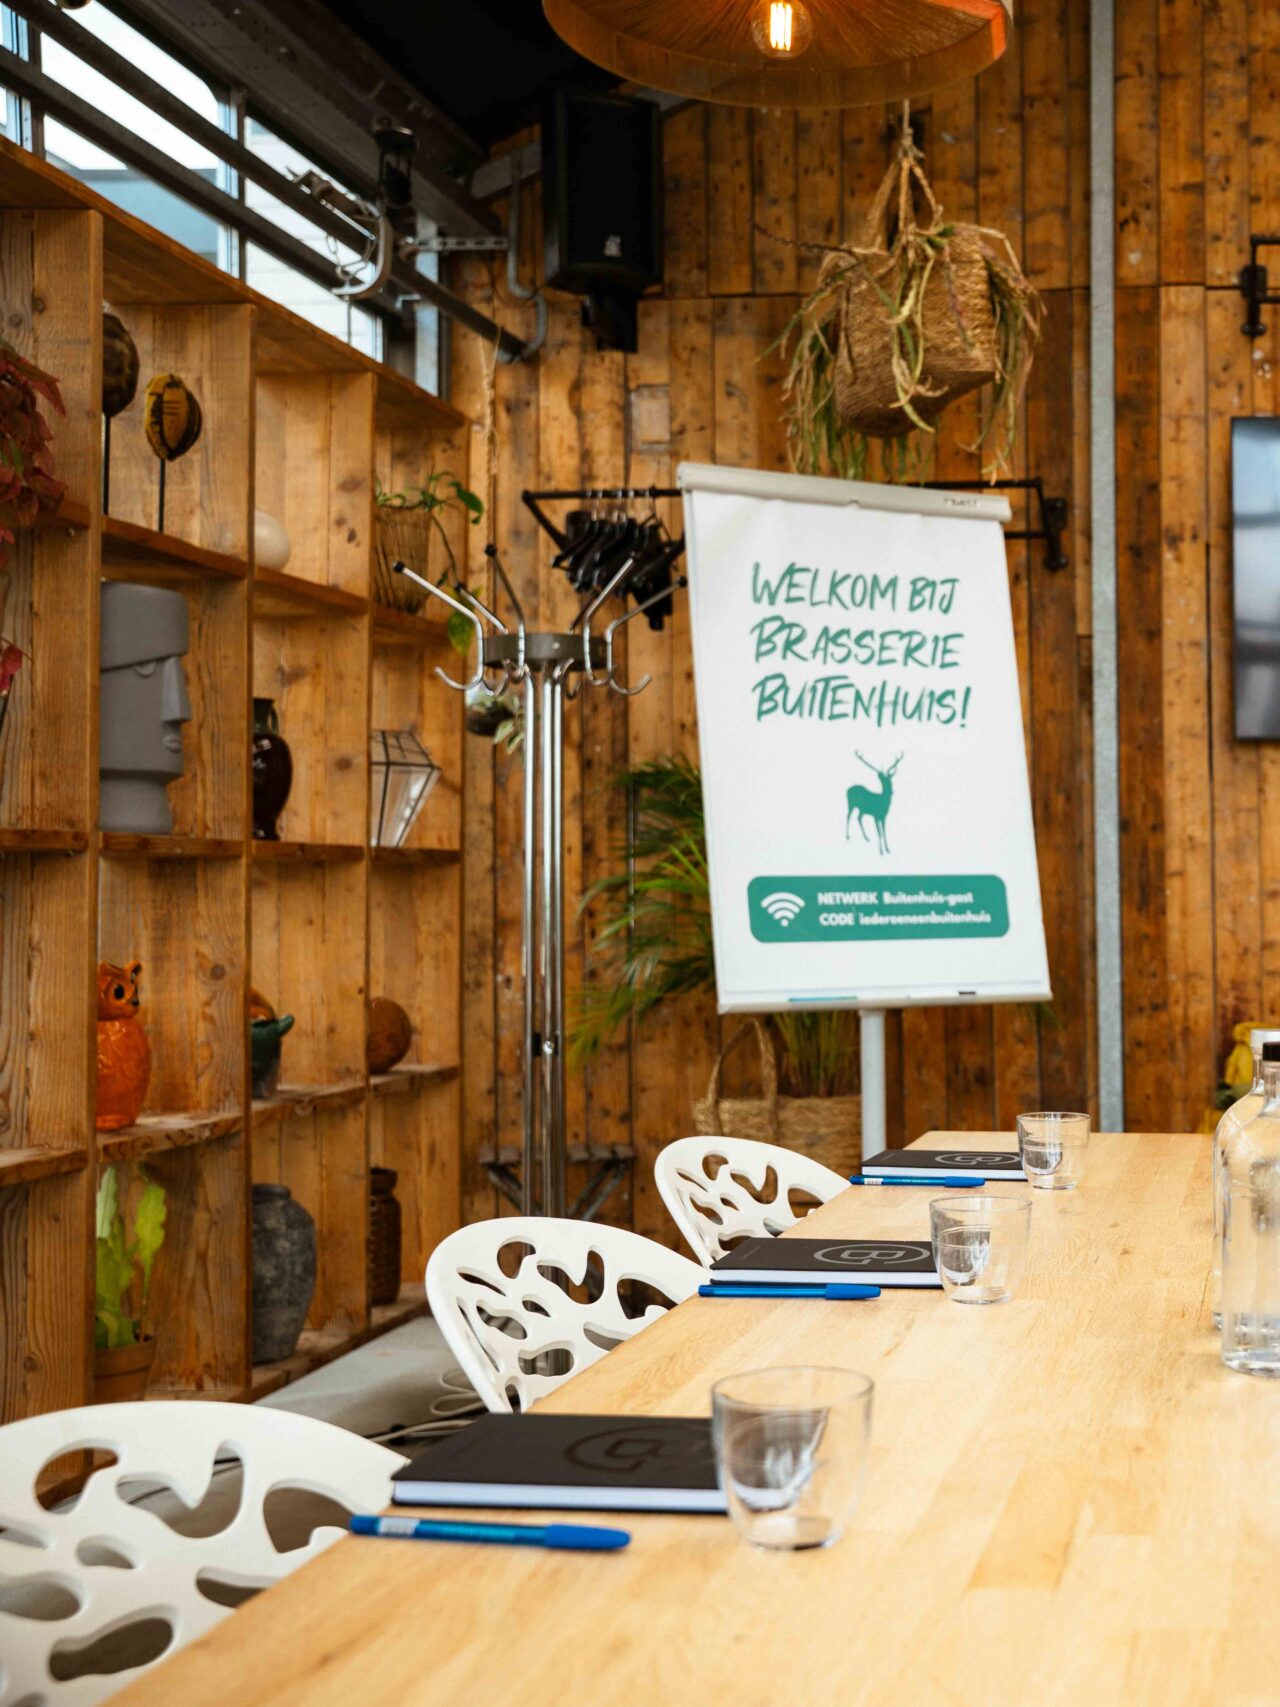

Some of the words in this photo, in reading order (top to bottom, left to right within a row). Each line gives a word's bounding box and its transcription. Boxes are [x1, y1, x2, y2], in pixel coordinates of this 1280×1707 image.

[752, 561, 899, 612] WELKOM
[908, 576, 961, 615] BIJ
[750, 615, 965, 669] BRASSERIE
[752, 672, 972, 728] BUITENHUIS!
[817, 891, 879, 906] NETWERK
[882, 890, 975, 907] Buitenhuis-gast
[819, 912, 855, 926] CODE
